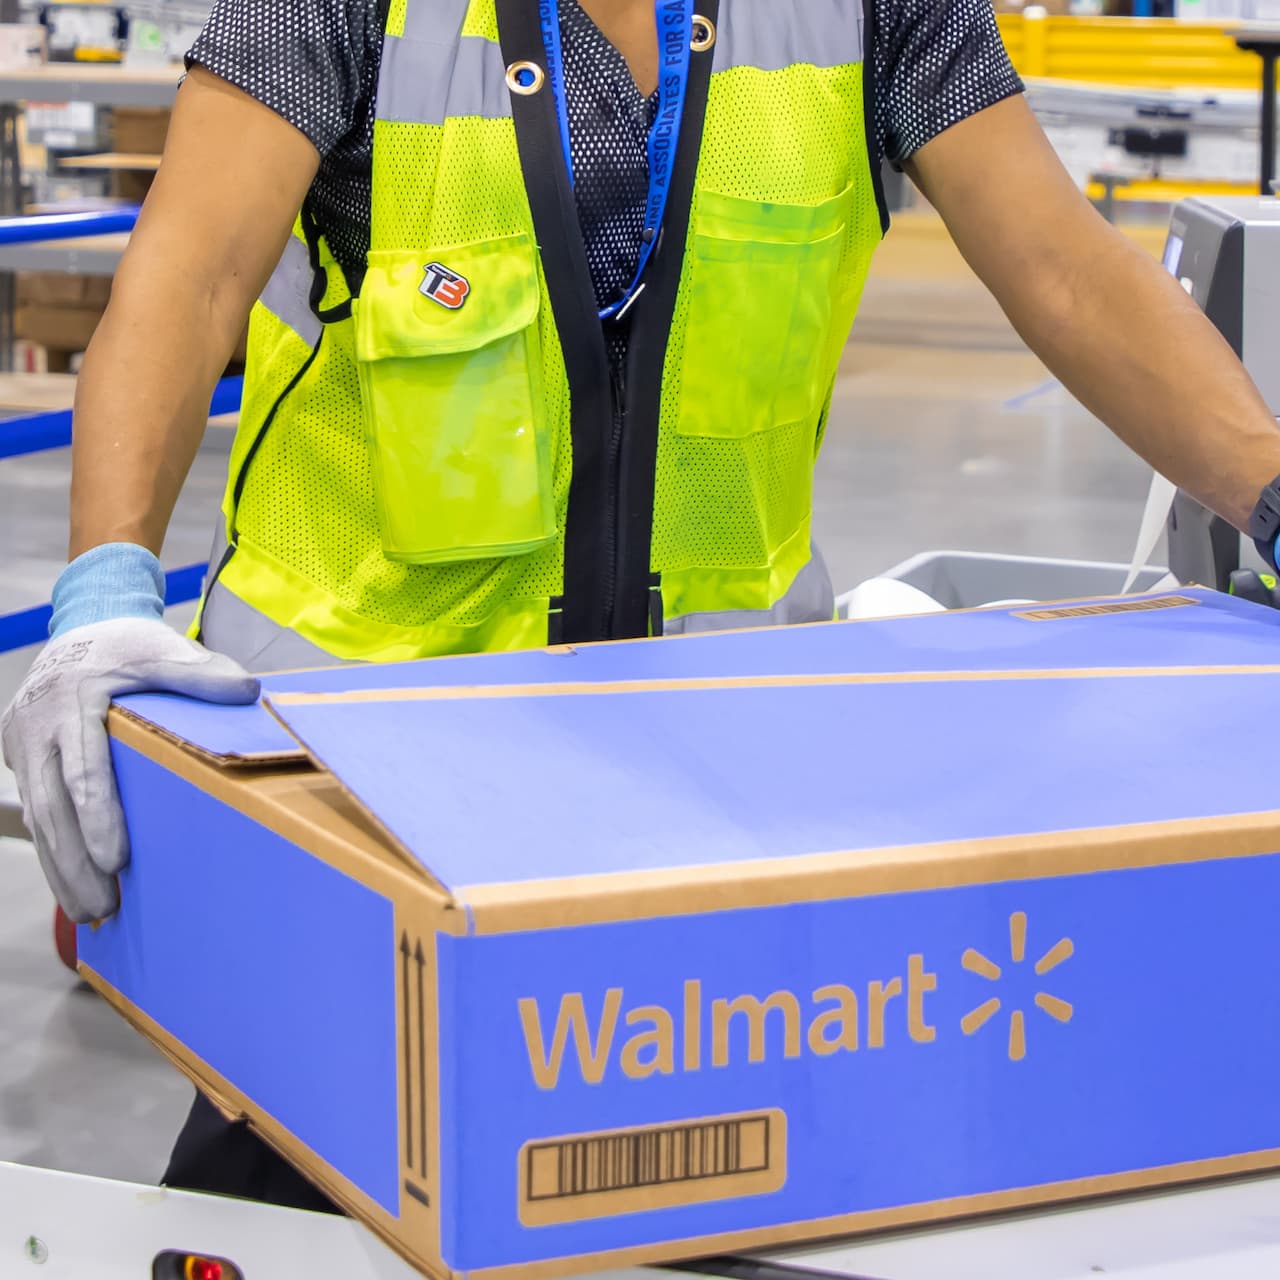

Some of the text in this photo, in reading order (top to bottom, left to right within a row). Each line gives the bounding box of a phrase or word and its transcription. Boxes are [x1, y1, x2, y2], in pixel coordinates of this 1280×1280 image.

[664, 29, 684, 67] FOR
[653, 74, 681, 188] ASSOCIATES
[518, 954, 938, 1090] Walmart
